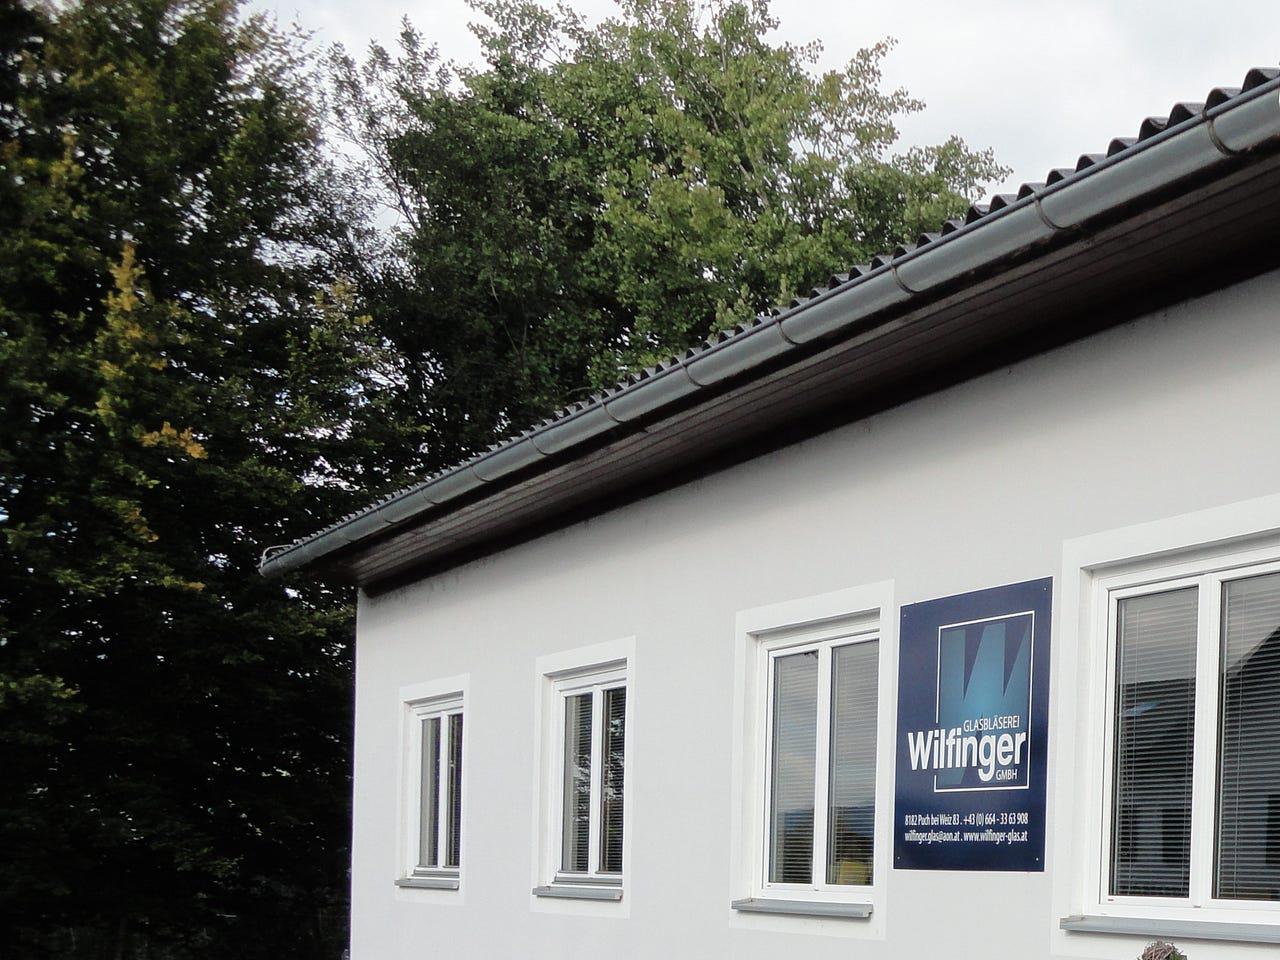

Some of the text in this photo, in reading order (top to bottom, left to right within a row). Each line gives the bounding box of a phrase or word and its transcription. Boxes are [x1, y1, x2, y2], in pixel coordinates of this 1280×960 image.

[963, 715, 1020, 732] GLASBLÄSEREI
[908, 728, 1026, 782] Wilfinger
[996, 769, 1018, 781] GMBH
[905, 815, 918, 826] 8182
[918, 814, 930, 825] Puch
[931, 813, 939, 825] bei
[940, 814, 952, 825] Weiz
[953, 814, 960, 825] 83
[964, 814, 975, 825] +43
[976, 813, 984, 826] (0)
[985, 813, 995, 824] 664
[1000, 813, 1007, 824] 33
[1009, 813, 1016, 824] 63
[1017, 812, 1028, 824] 908
[963, 829, 1028, 844] www.wilfinger-glas.at
